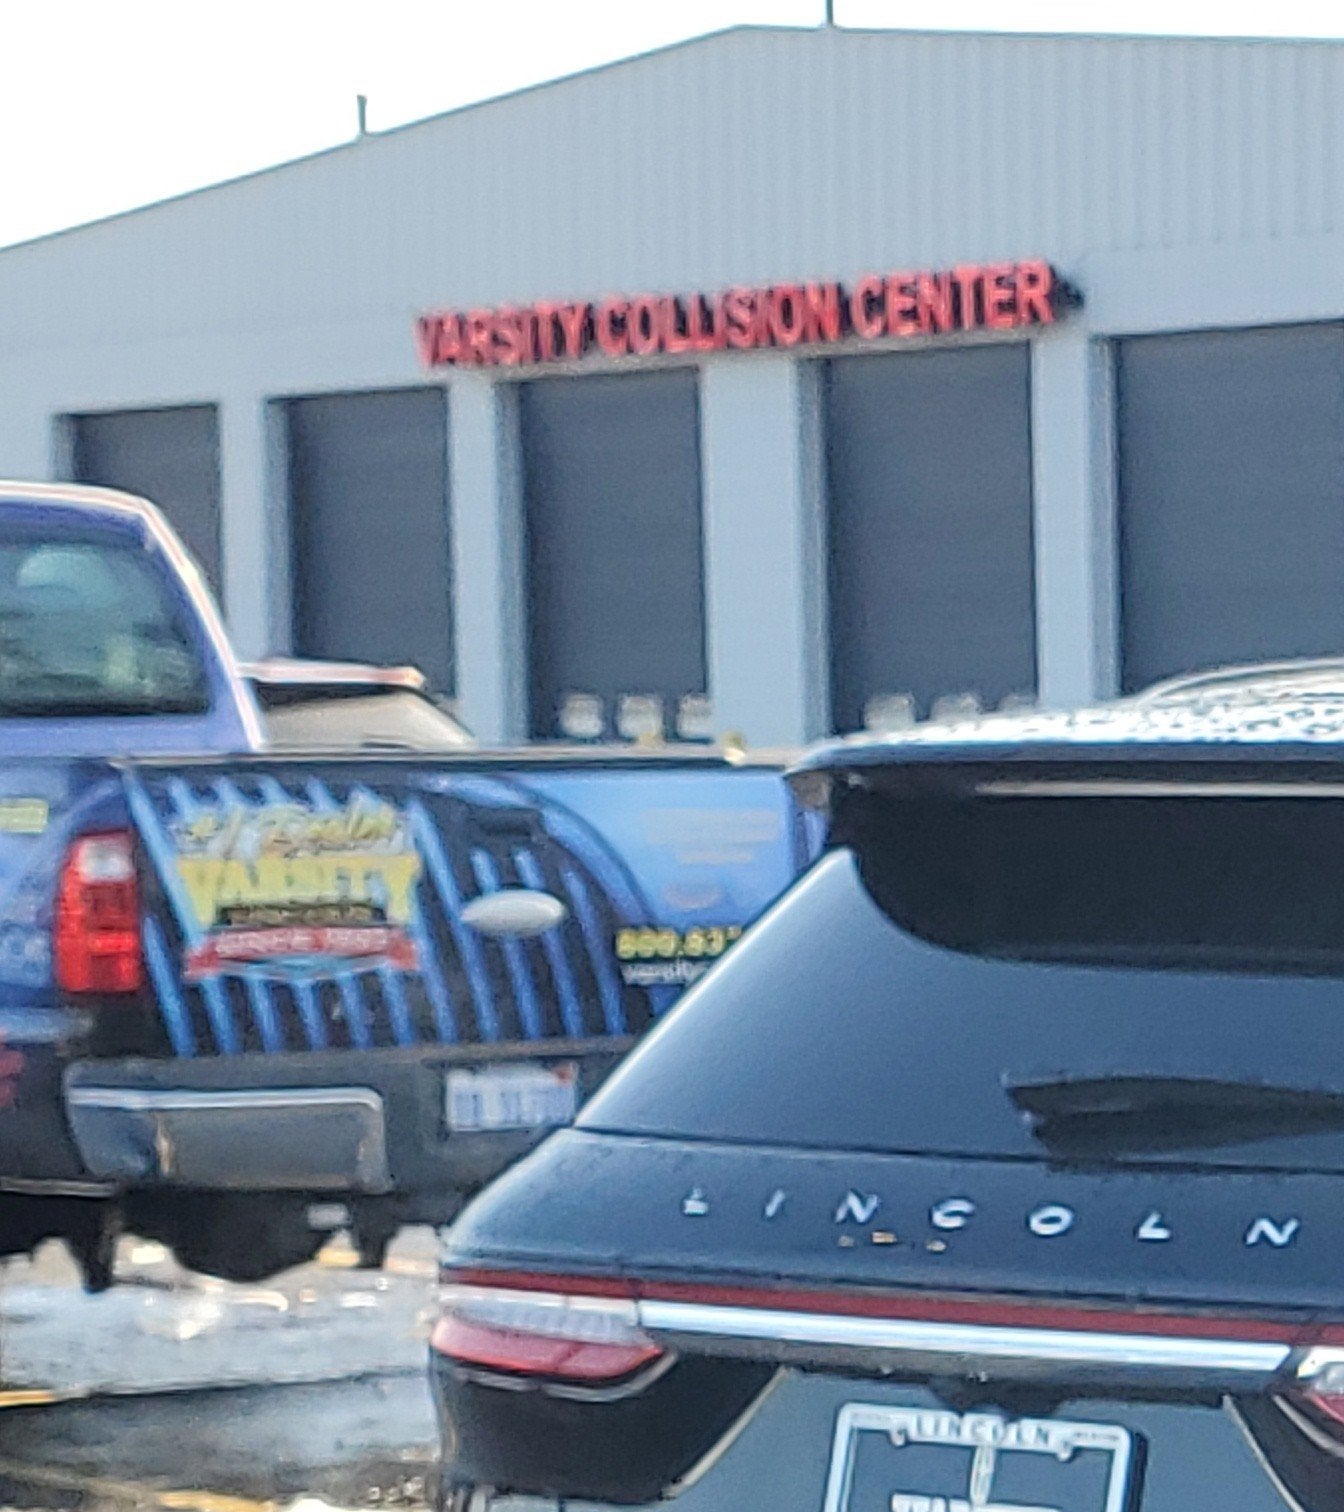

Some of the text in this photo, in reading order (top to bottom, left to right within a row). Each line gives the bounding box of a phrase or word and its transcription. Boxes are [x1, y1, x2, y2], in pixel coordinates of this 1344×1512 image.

[413, 259, 1054, 368] VARSITY COLLISION CENTER
[684, 1189, 1299, 1246] LINCOLN
